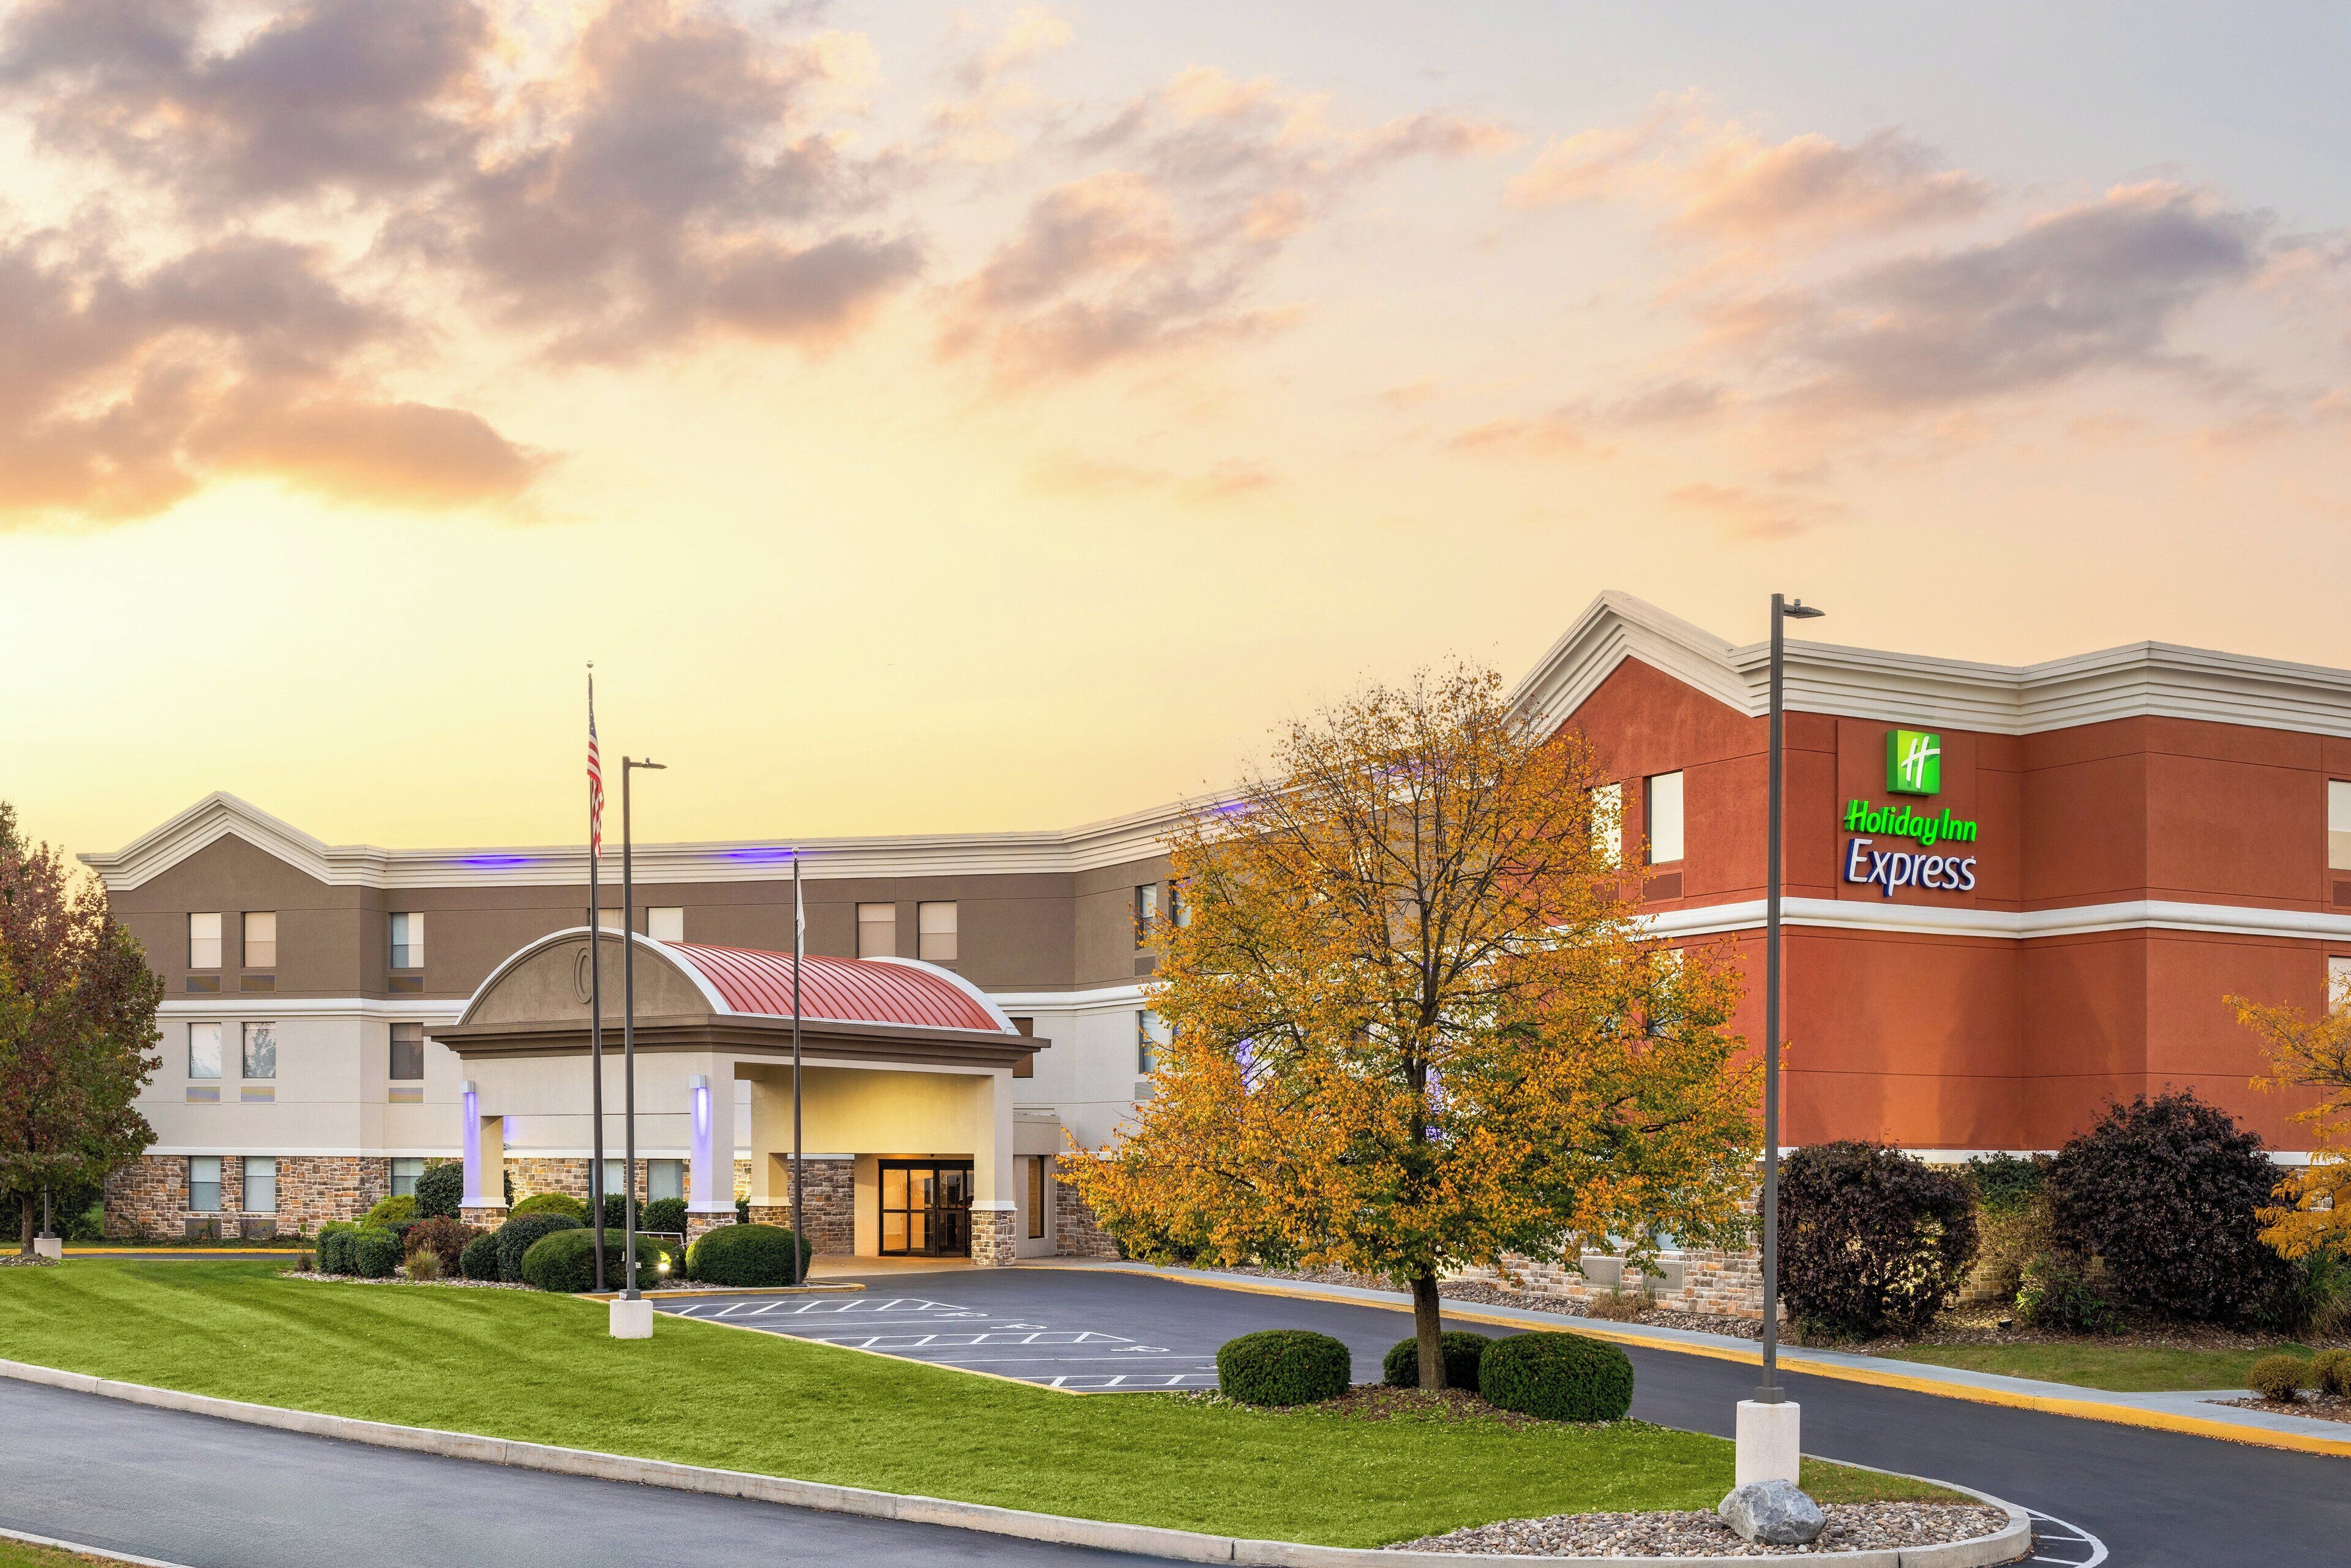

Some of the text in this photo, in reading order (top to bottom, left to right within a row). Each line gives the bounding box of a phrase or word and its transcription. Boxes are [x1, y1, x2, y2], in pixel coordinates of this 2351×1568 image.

[1843, 800, 1977, 846] Holiday Inn
[1845, 838, 1977, 896] Express
